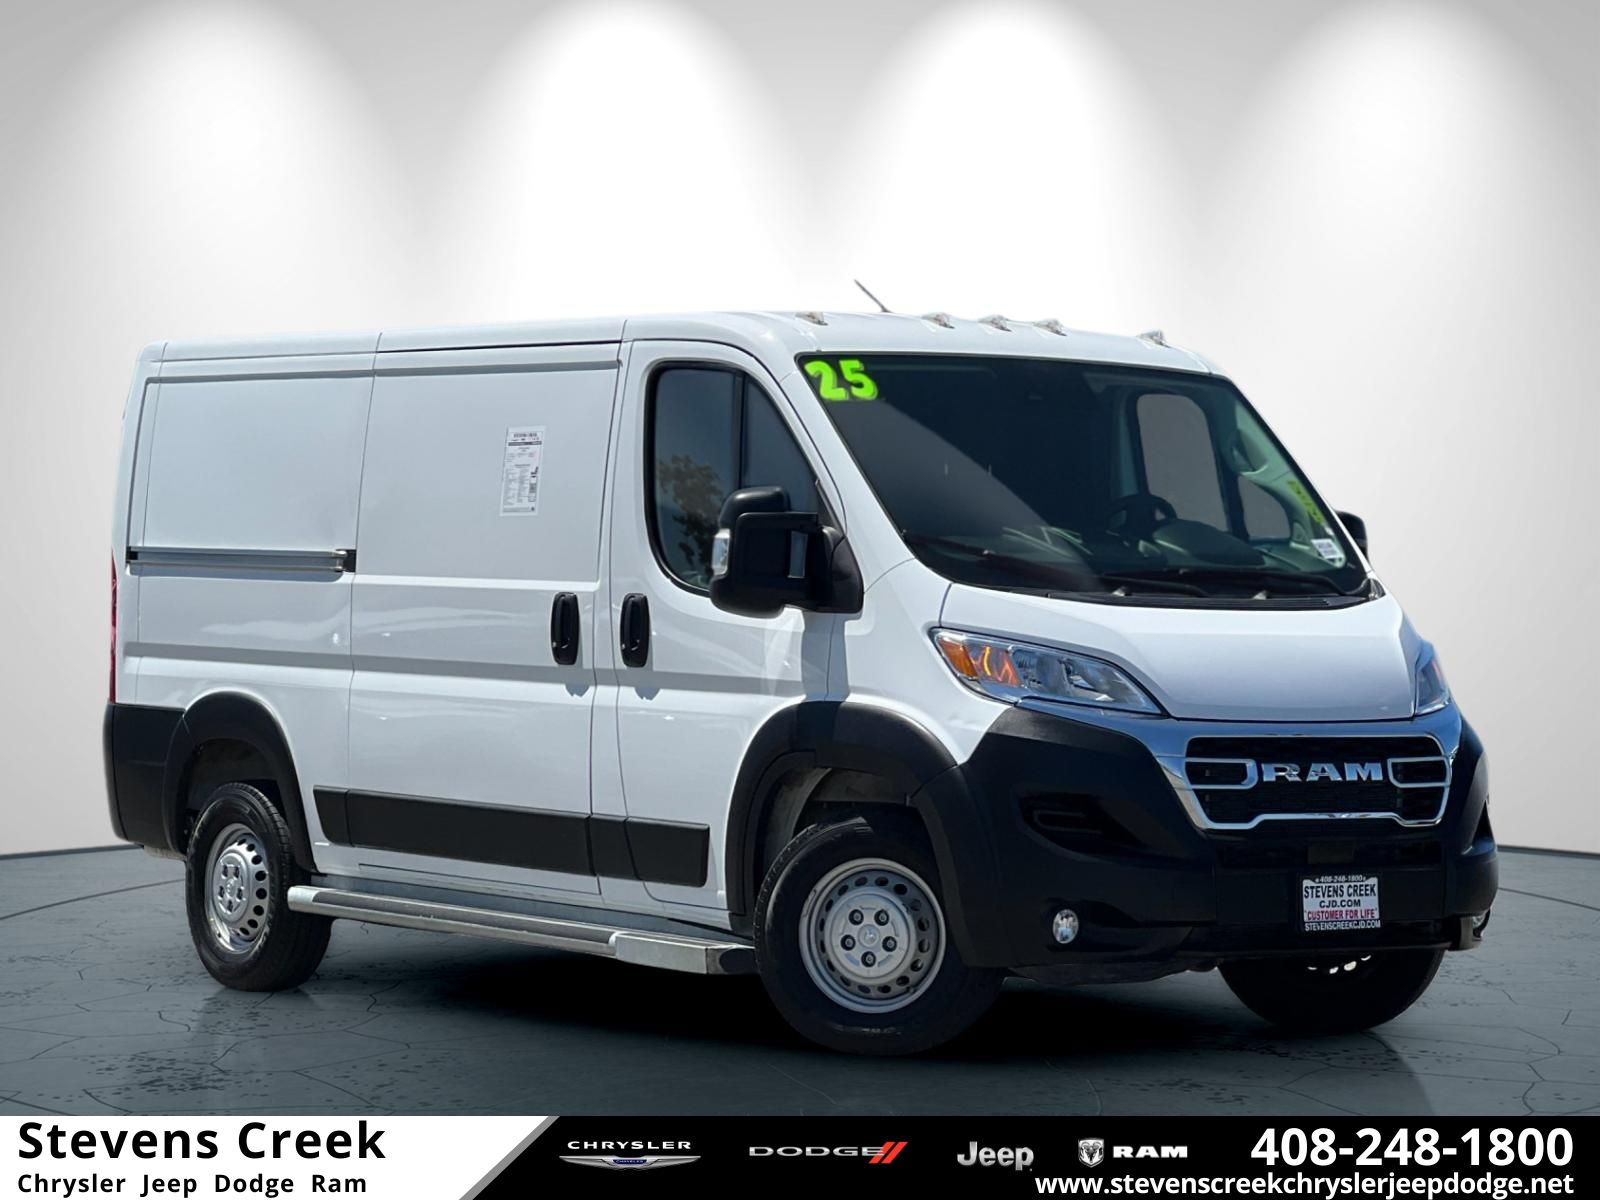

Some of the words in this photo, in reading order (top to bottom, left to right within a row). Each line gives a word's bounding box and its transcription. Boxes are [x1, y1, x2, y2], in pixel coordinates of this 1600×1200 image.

[804, 358, 878, 401] 25
[1262, 762, 1383, 782] RAM
[1304, 884, 1344, 898] STEVENS
[1347, 883, 1376, 897] CREEK
[1320, 899, 1361, 908] CJD.COM
[1345, 909, 1358, 919] FOR
